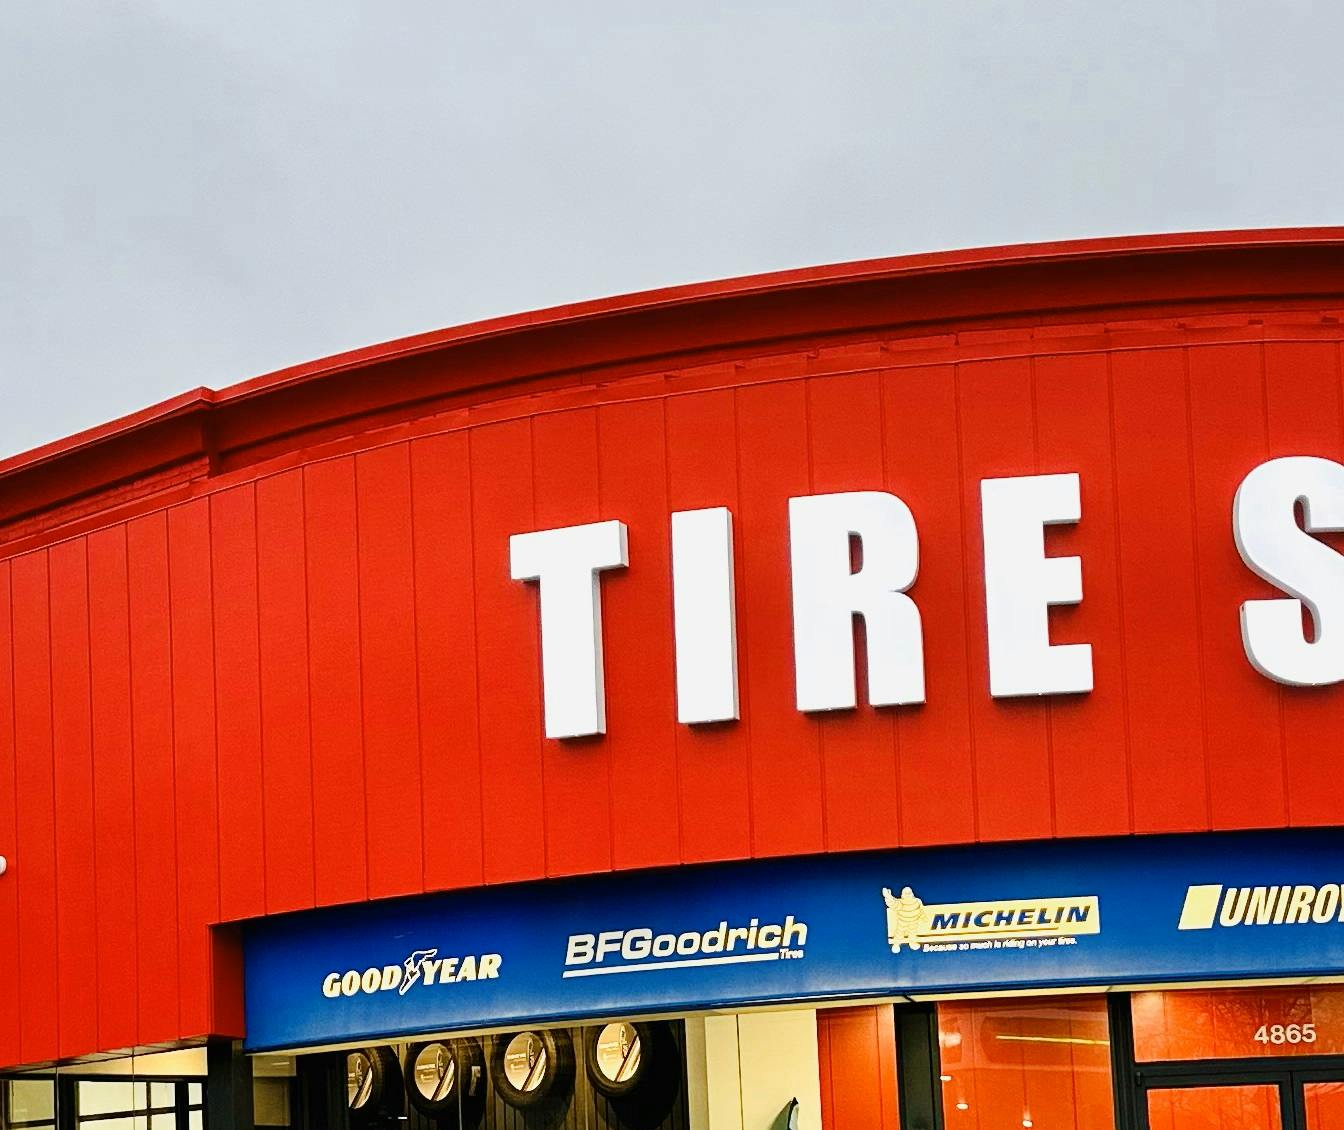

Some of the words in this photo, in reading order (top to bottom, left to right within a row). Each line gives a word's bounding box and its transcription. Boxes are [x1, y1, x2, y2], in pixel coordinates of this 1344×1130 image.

[510, 472, 1094, 740] TIRE
[930, 905, 1091, 931] MICHELIN
[565, 916, 808, 966] BFGoodrich
[1254, 1023, 1317, 1045] 4865
